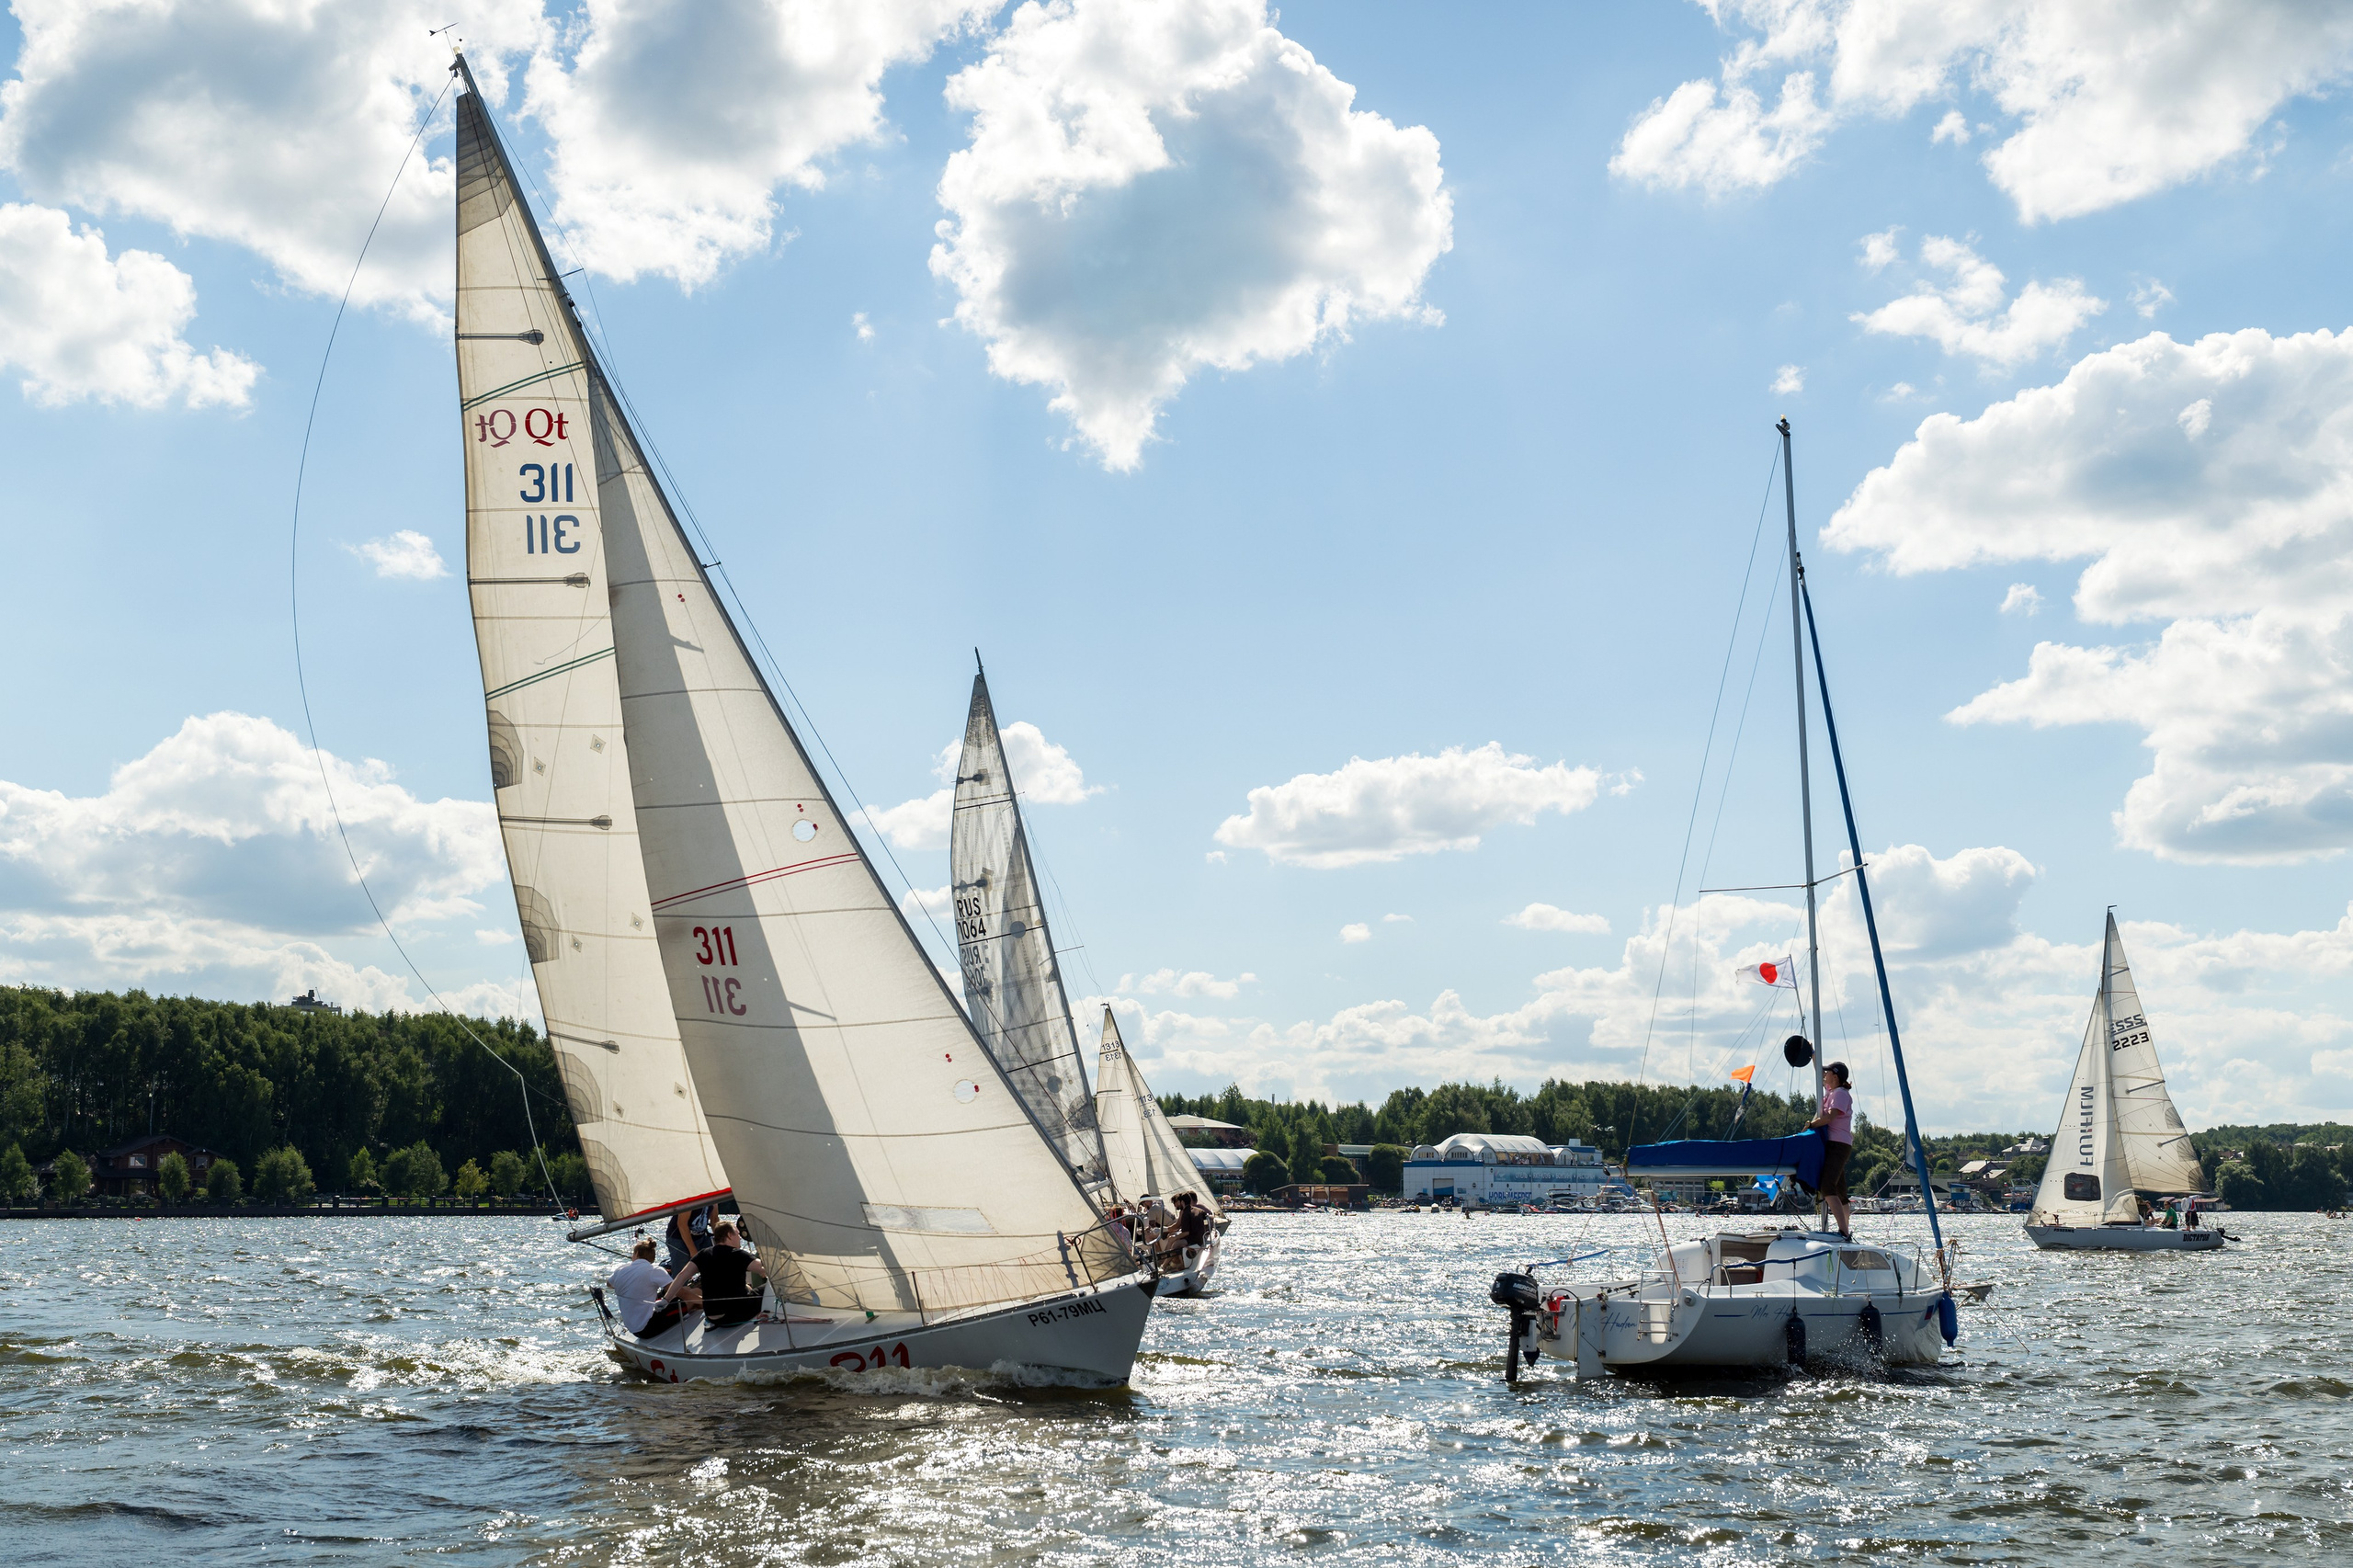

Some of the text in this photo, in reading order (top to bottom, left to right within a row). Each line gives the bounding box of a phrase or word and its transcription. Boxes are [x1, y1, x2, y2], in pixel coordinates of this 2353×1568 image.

[525, 408, 569, 447] Qt
[519, 462, 573, 503] 311
[957, 897, 981, 917] RUS
[958, 918, 986, 940] 1064
[693, 926, 738, 966] 311
[2112, 1032, 2149, 1051] 2223
[2183, 1233, 2210, 1242] DICTATOR
[1028, 1299, 1107, 1326] Р61-79МЦ
